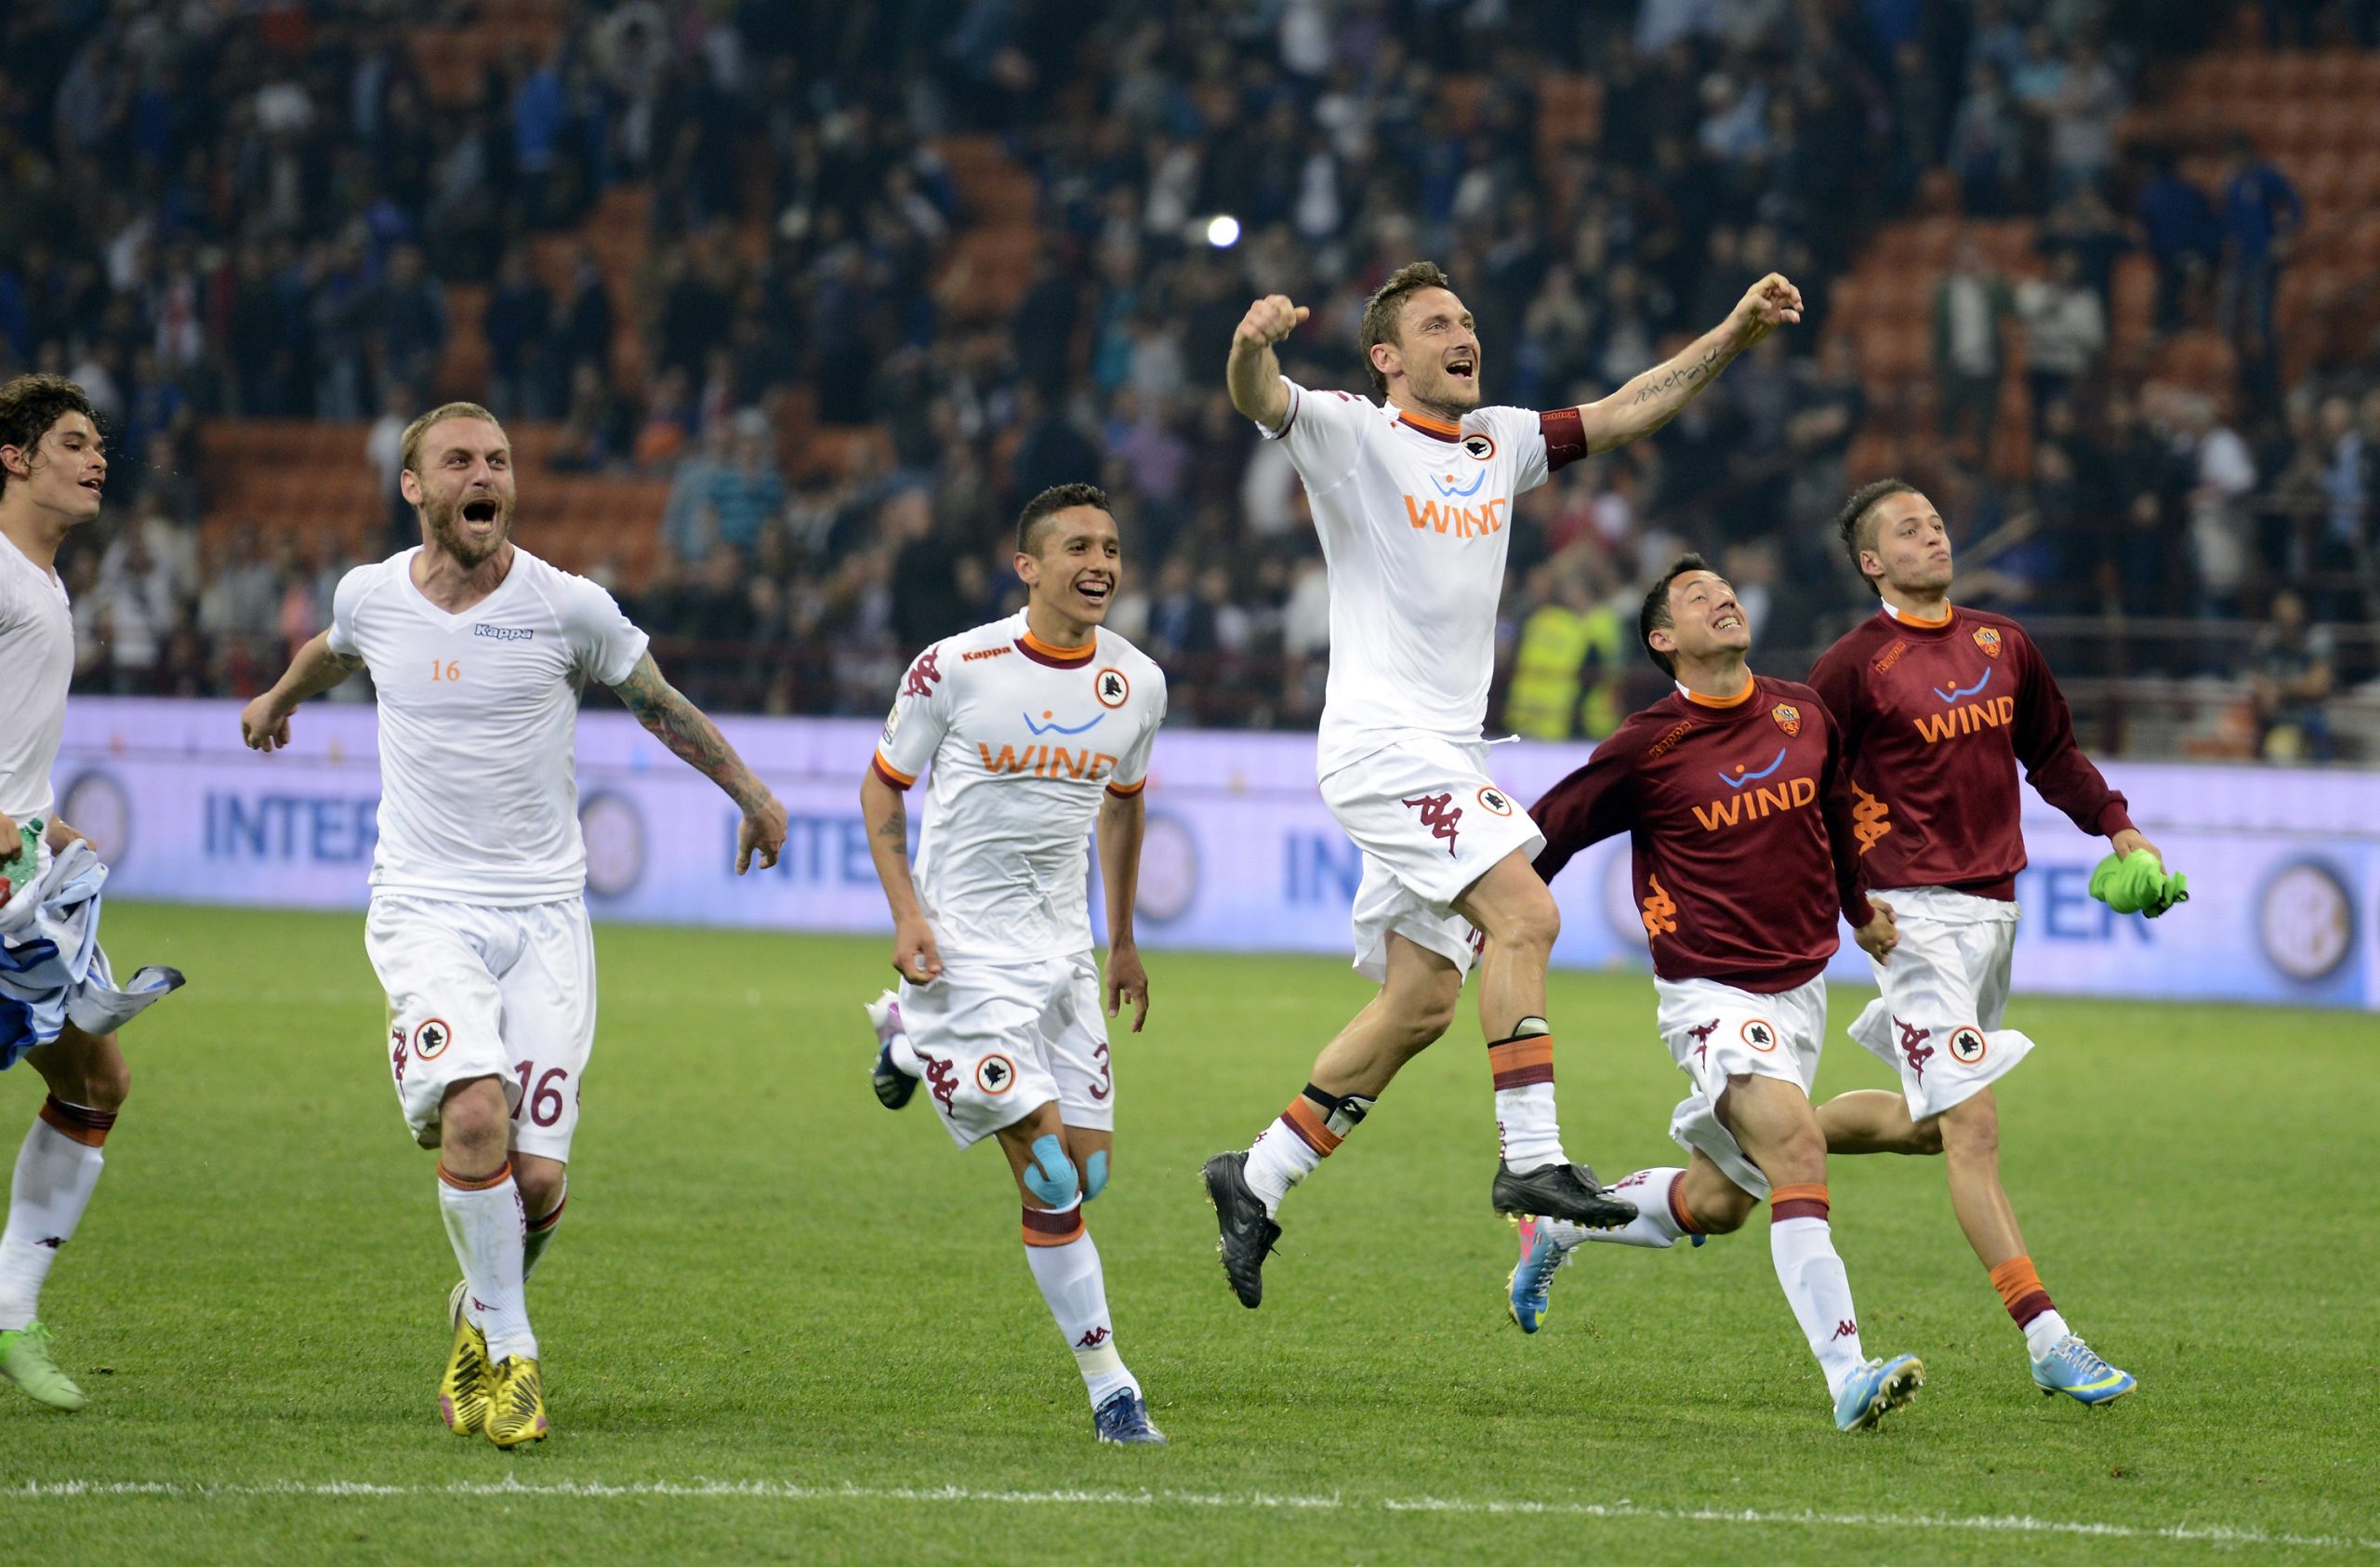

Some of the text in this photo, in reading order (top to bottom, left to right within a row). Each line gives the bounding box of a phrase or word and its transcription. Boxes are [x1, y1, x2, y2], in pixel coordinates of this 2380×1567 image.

[1404, 494, 1506, 538] WIND
[474, 623, 534, 641] Kappa
[961, 645, 1012, 663] Kappa
[431, 658, 461, 683] 16
[1912, 696, 2015, 744] WIND
[978, 741, 1118, 781] WIND
[1691, 777, 1817, 826] WIND
[510, 1059, 568, 1128] 16
[1088, 1042, 1111, 1101] 3
